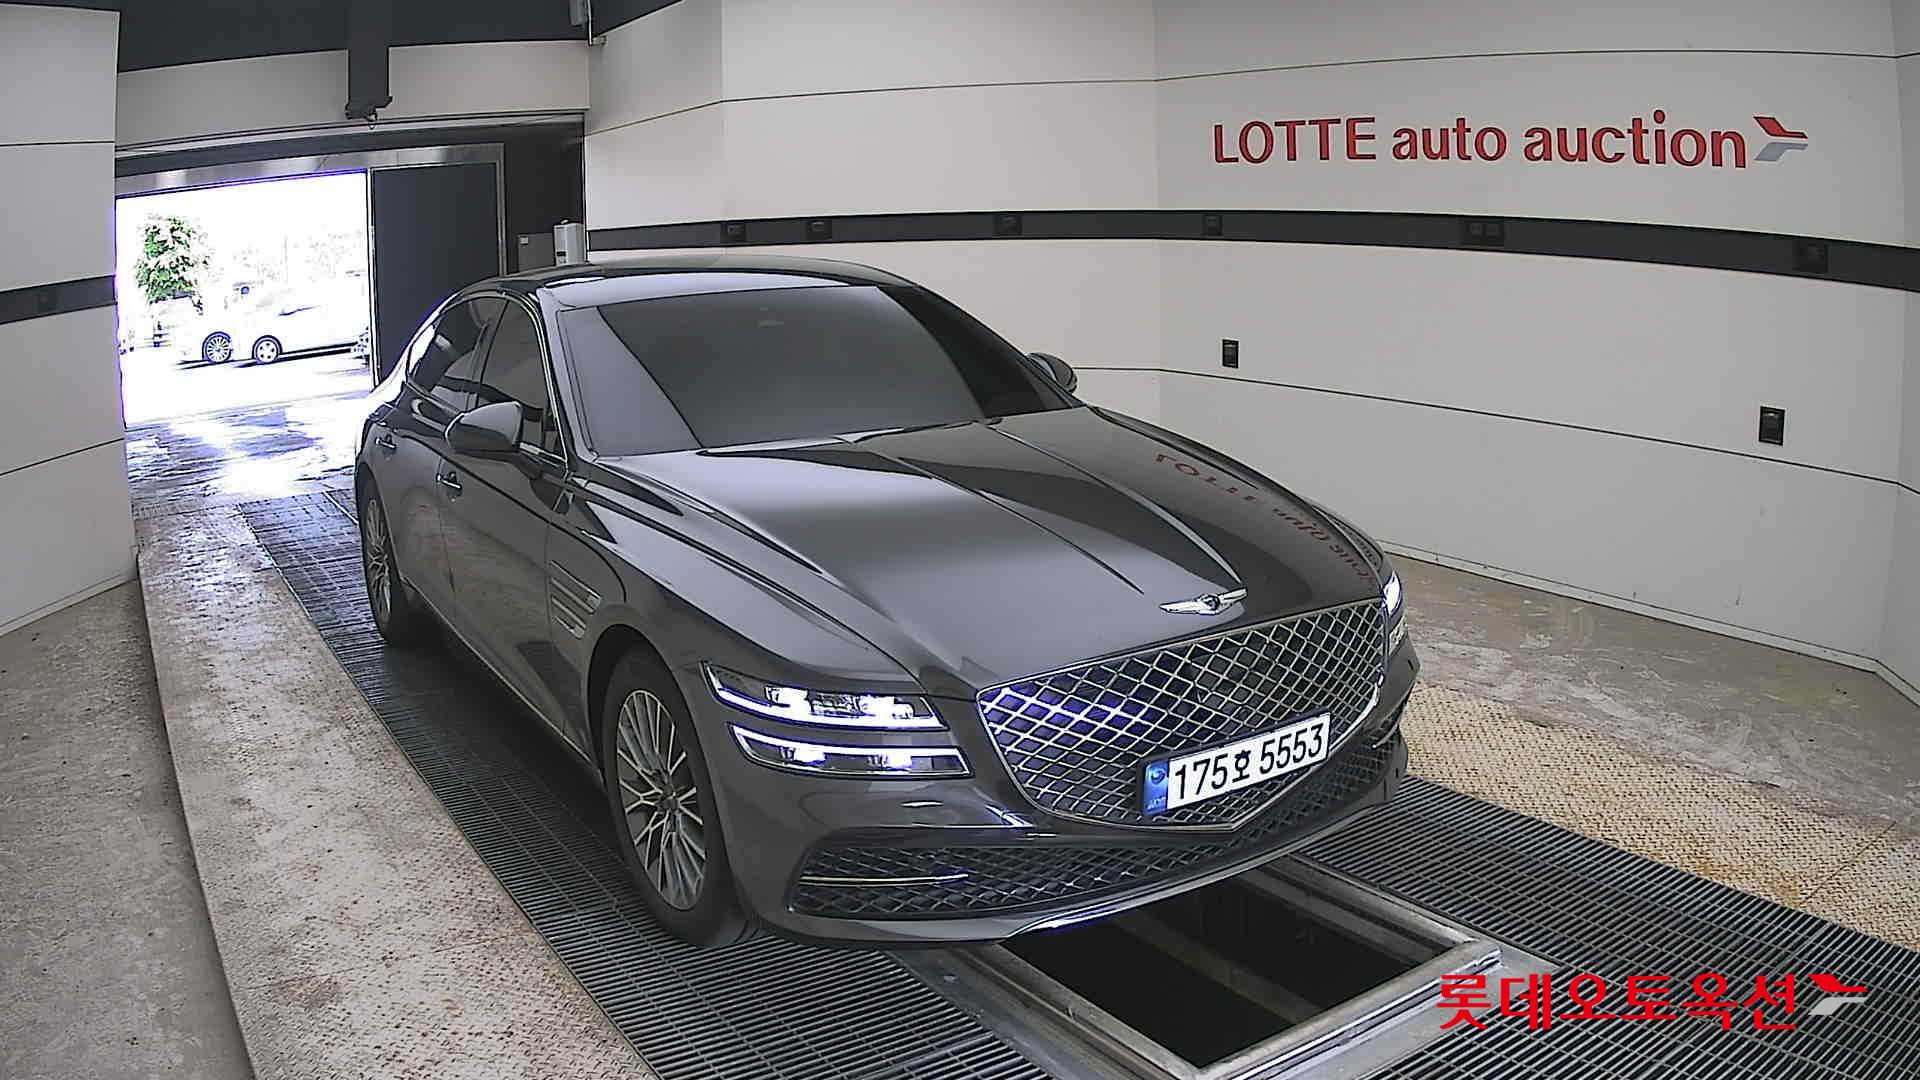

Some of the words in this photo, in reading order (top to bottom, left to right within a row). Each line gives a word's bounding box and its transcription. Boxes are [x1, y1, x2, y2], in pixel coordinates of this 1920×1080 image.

[1214, 116, 1377, 164] LOTTE
[1391, 117, 1508, 162] auto
[1522, 109, 1747, 169] auction
[1174, 749, 1252, 800] 175호
[1259, 722, 1325, 775] 5553
